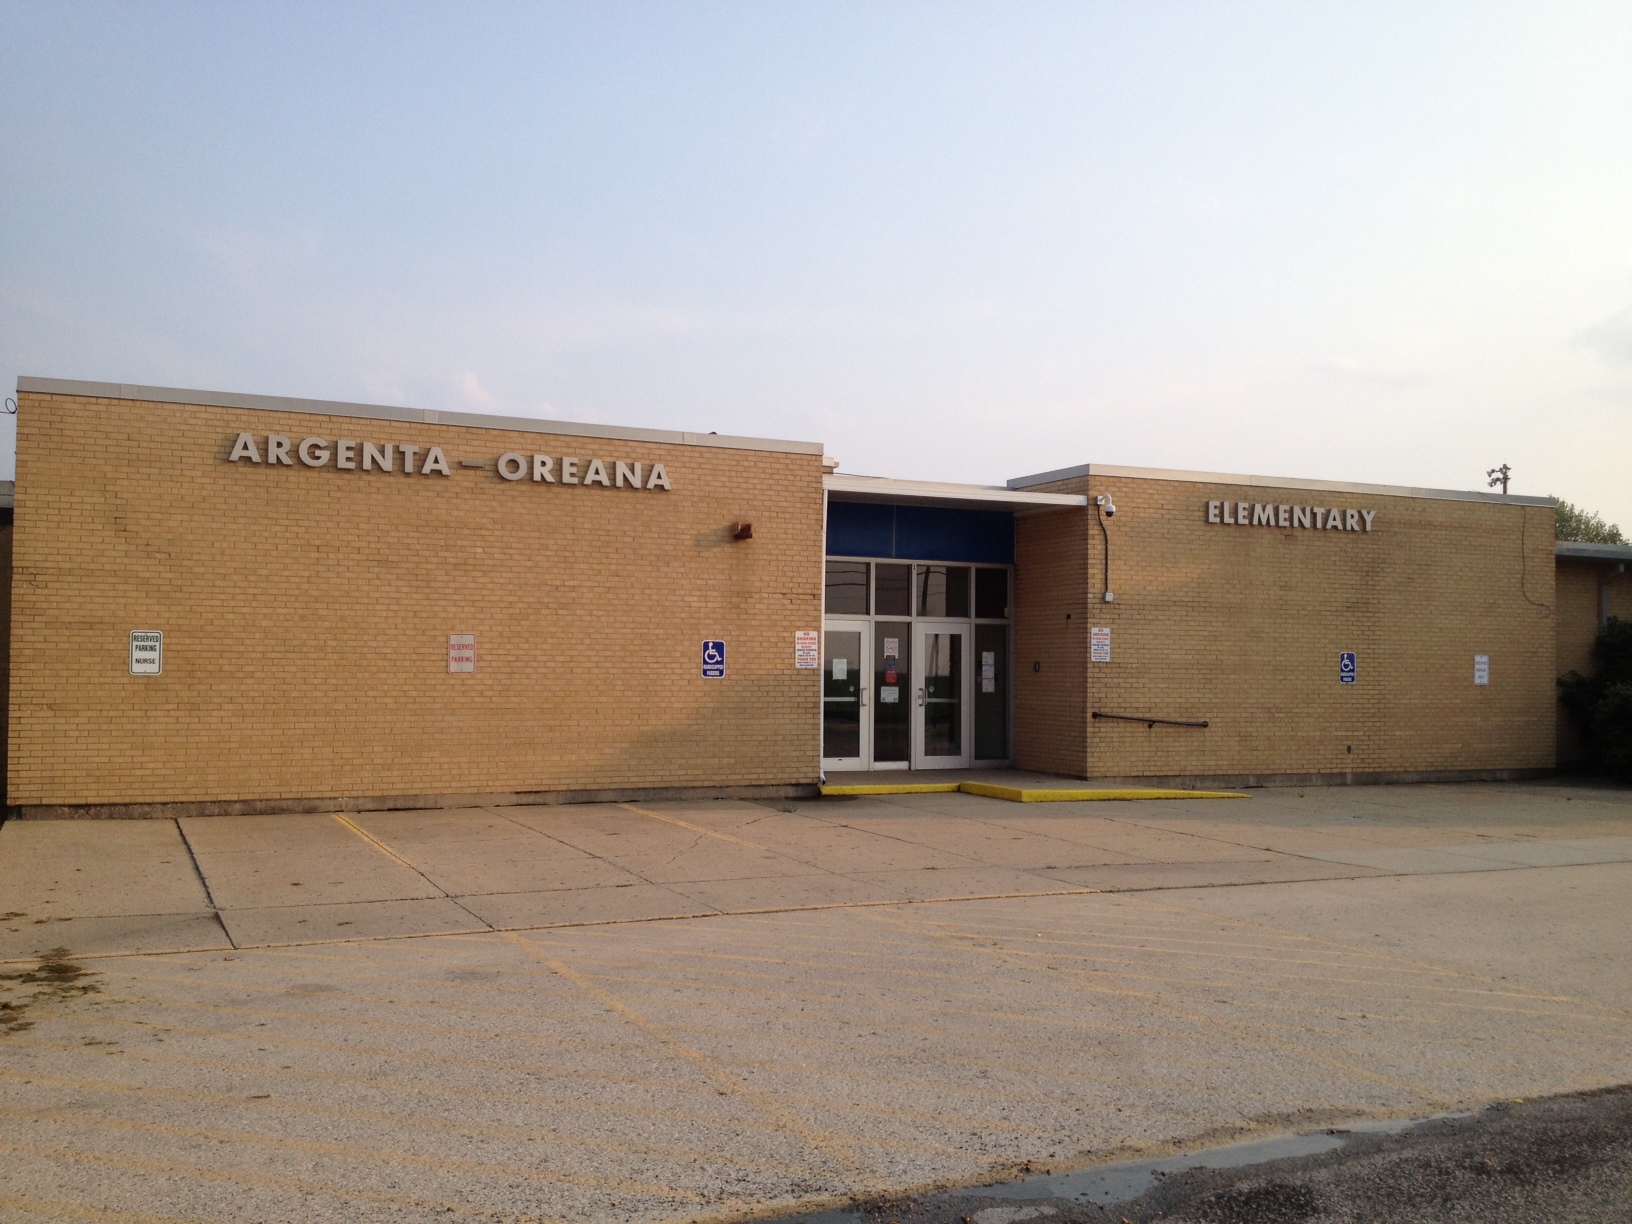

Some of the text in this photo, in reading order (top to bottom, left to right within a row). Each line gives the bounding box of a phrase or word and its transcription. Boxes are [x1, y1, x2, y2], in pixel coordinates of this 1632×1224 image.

[229, 432, 450, 476] ARGENTA
[497, 452, 672, 491] OREANA
[1207, 500, 1376, 532] ELEMENTARY
[133, 635, 159, 643] RESERVED
[135, 644, 157, 652] PARKING
